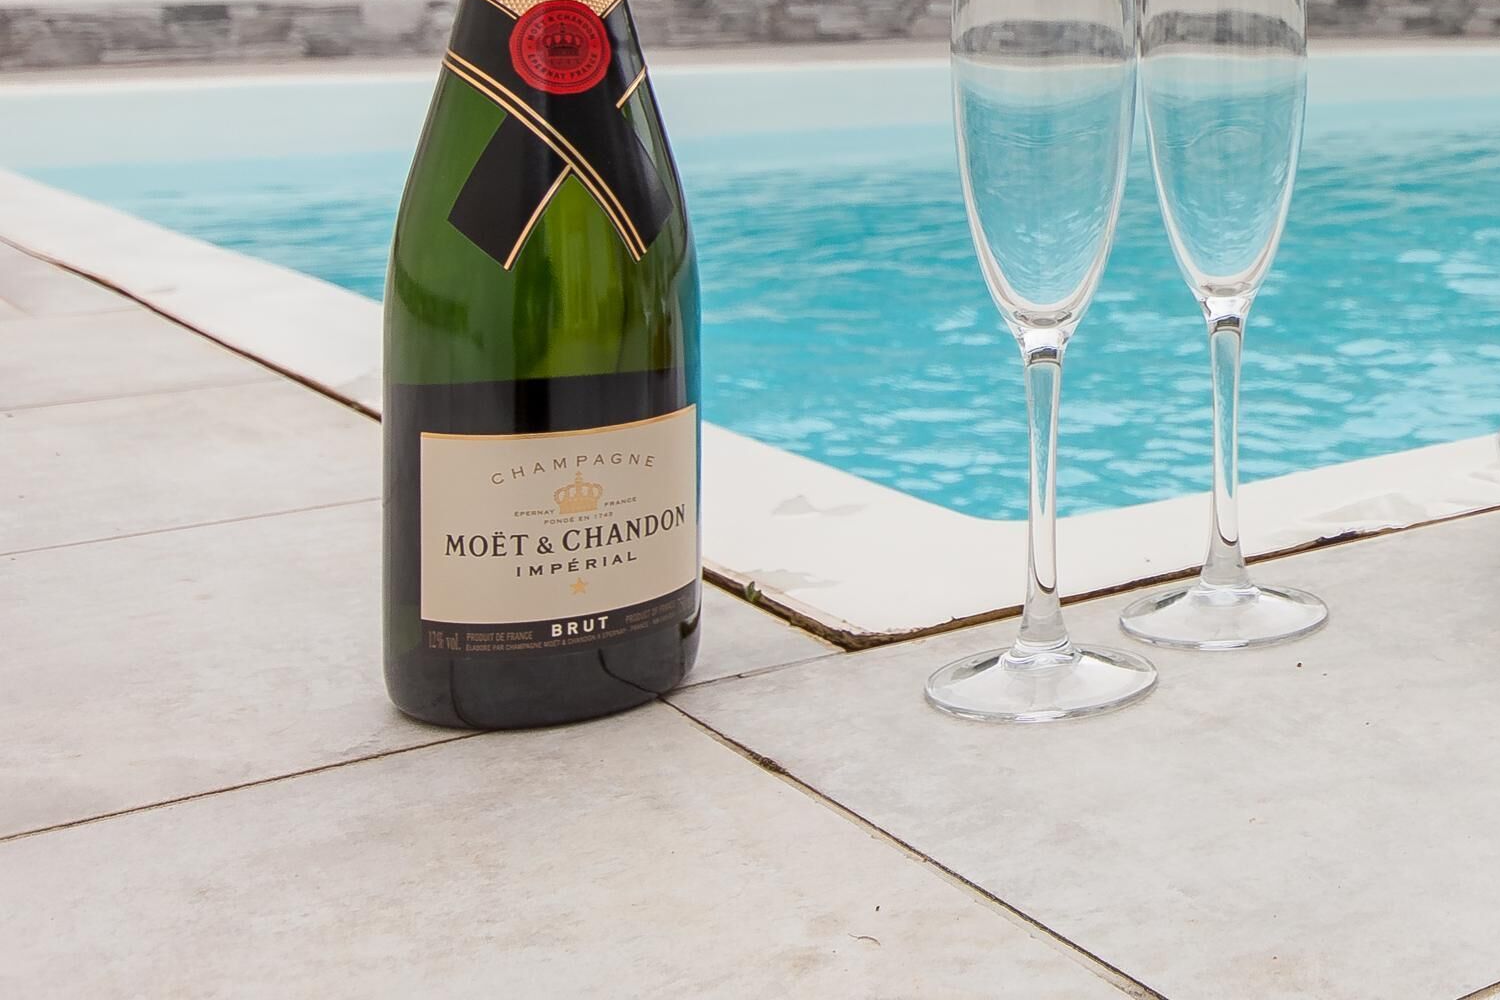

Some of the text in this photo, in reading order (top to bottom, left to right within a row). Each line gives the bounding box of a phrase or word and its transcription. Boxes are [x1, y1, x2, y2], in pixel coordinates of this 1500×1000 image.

[491, 452, 655, 485] CHAMPAGNE
[604, 497, 637, 506] FRANCE
[445, 503, 685, 557] MOËT & CHANDON
[516, 551, 637, 577] IMPÉRIAL
[495, 632, 504, 642] DE
[506, 631, 533, 641] FRANCE
[551, 616, 609, 637] BRUT
